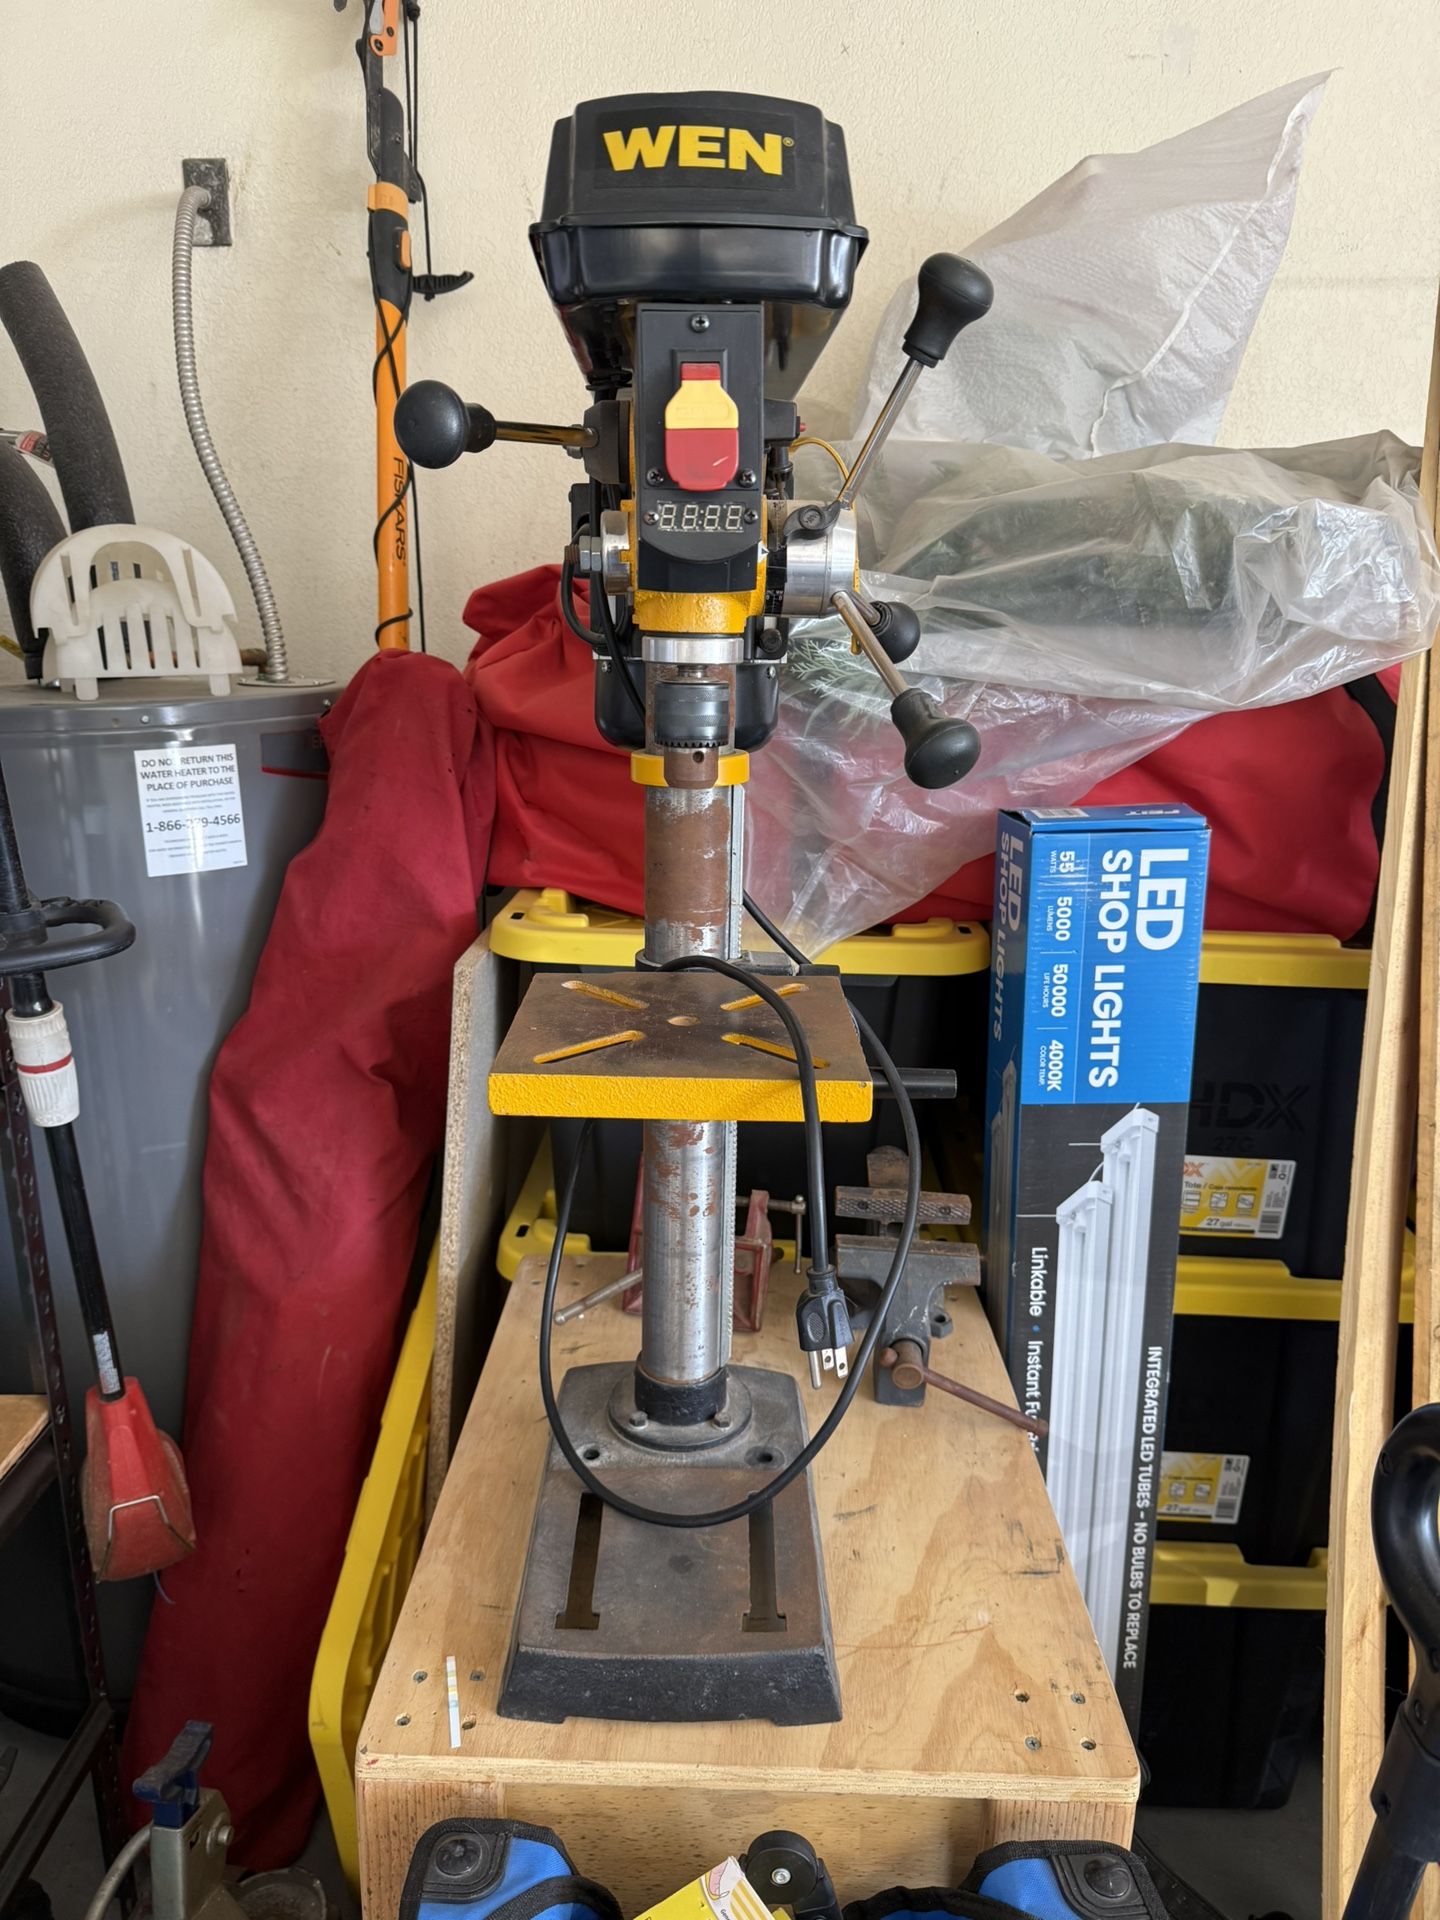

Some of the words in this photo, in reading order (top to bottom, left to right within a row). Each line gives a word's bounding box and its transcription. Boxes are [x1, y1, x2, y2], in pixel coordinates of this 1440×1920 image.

[140, 770, 173, 780] WATER
[174, 766, 207, 777] HEATER
[209, 766, 220, 774] TO
[220, 765, 235, 773] THE
[141, 759, 156, 768] DO
[180, 755, 214, 765] RETURN
[216, 753, 234, 762] THIS
[146, 781, 175, 791] PLACE
[176, 780, 189, 789] OF
[190, 777, 234, 788] PURCHASE
[999, 831, 1009, 925] SHOP
[1008, 836, 1024, 931] LED
[1060, 851, 1075, 873] 55
[1046, 905, 1054, 932] LUMENS
[1055, 896, 1072, 941] 5000
[1098, 849, 1133, 953] SHOP
[1136, 848, 1189, 951] LED
[994, 929, 1006, 1041] LIGHTS
[1088, 964, 1126, 1088] LIGHTS
[1047, 1040, 1064, 1092] 4000K
[1206, 1218, 1220, 1226] 27
[1029, 1247, 1048, 1316] Linkable
[1025, 1341, 1044, 1398] Instant
[1142, 1346, 1163, 1434] INTEGRATED
[1140, 1437, 1156, 1462] LED
[1136, 1464, 1153, 1508] TUBES
[1133, 1522, 1149, 1544] NO
[1129, 1546, 1146, 1589] BULBS
[1127, 1591, 1143, 1610] TO
[1123, 1612, 1141, 1669] REPLACE
